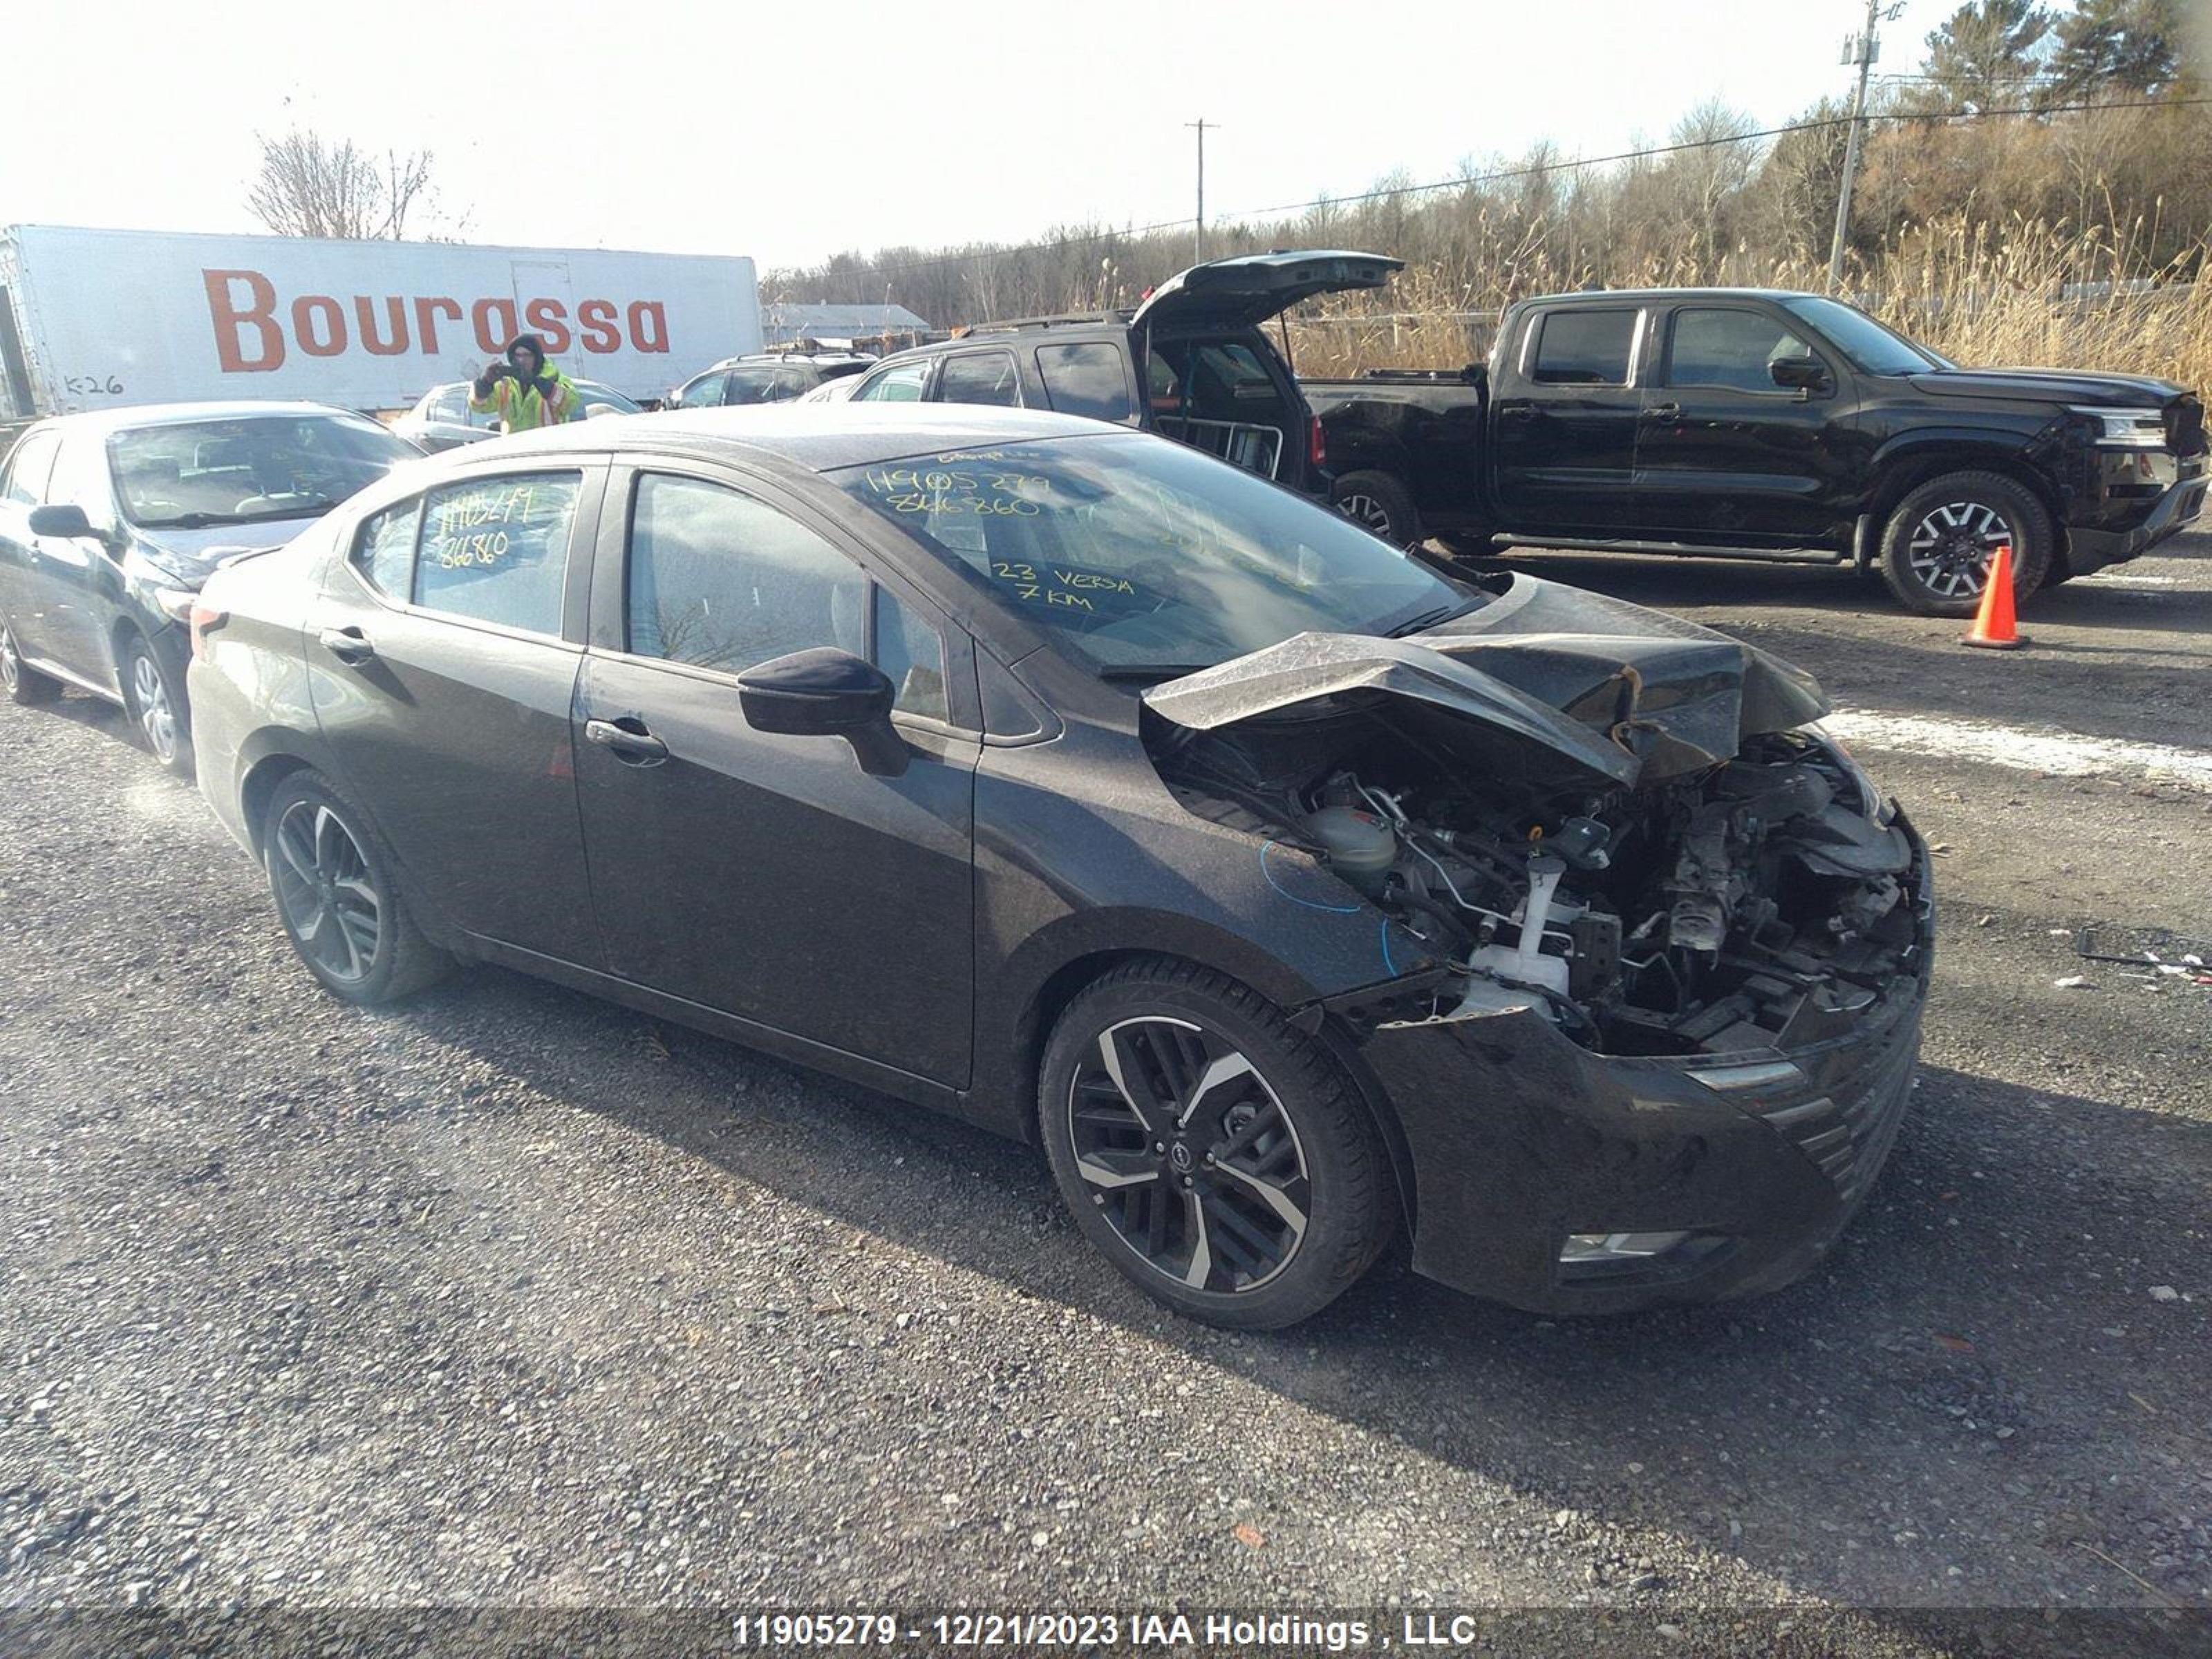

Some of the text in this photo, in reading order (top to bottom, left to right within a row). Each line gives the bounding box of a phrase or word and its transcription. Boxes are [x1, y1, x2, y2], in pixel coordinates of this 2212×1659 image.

[201, 268, 671, 373] Bourassa
[64, 375, 124, 395] K-26
[993, 563, 1135, 594] 23 VERSA
[1015, 583, 1094, 610] 7 KM
